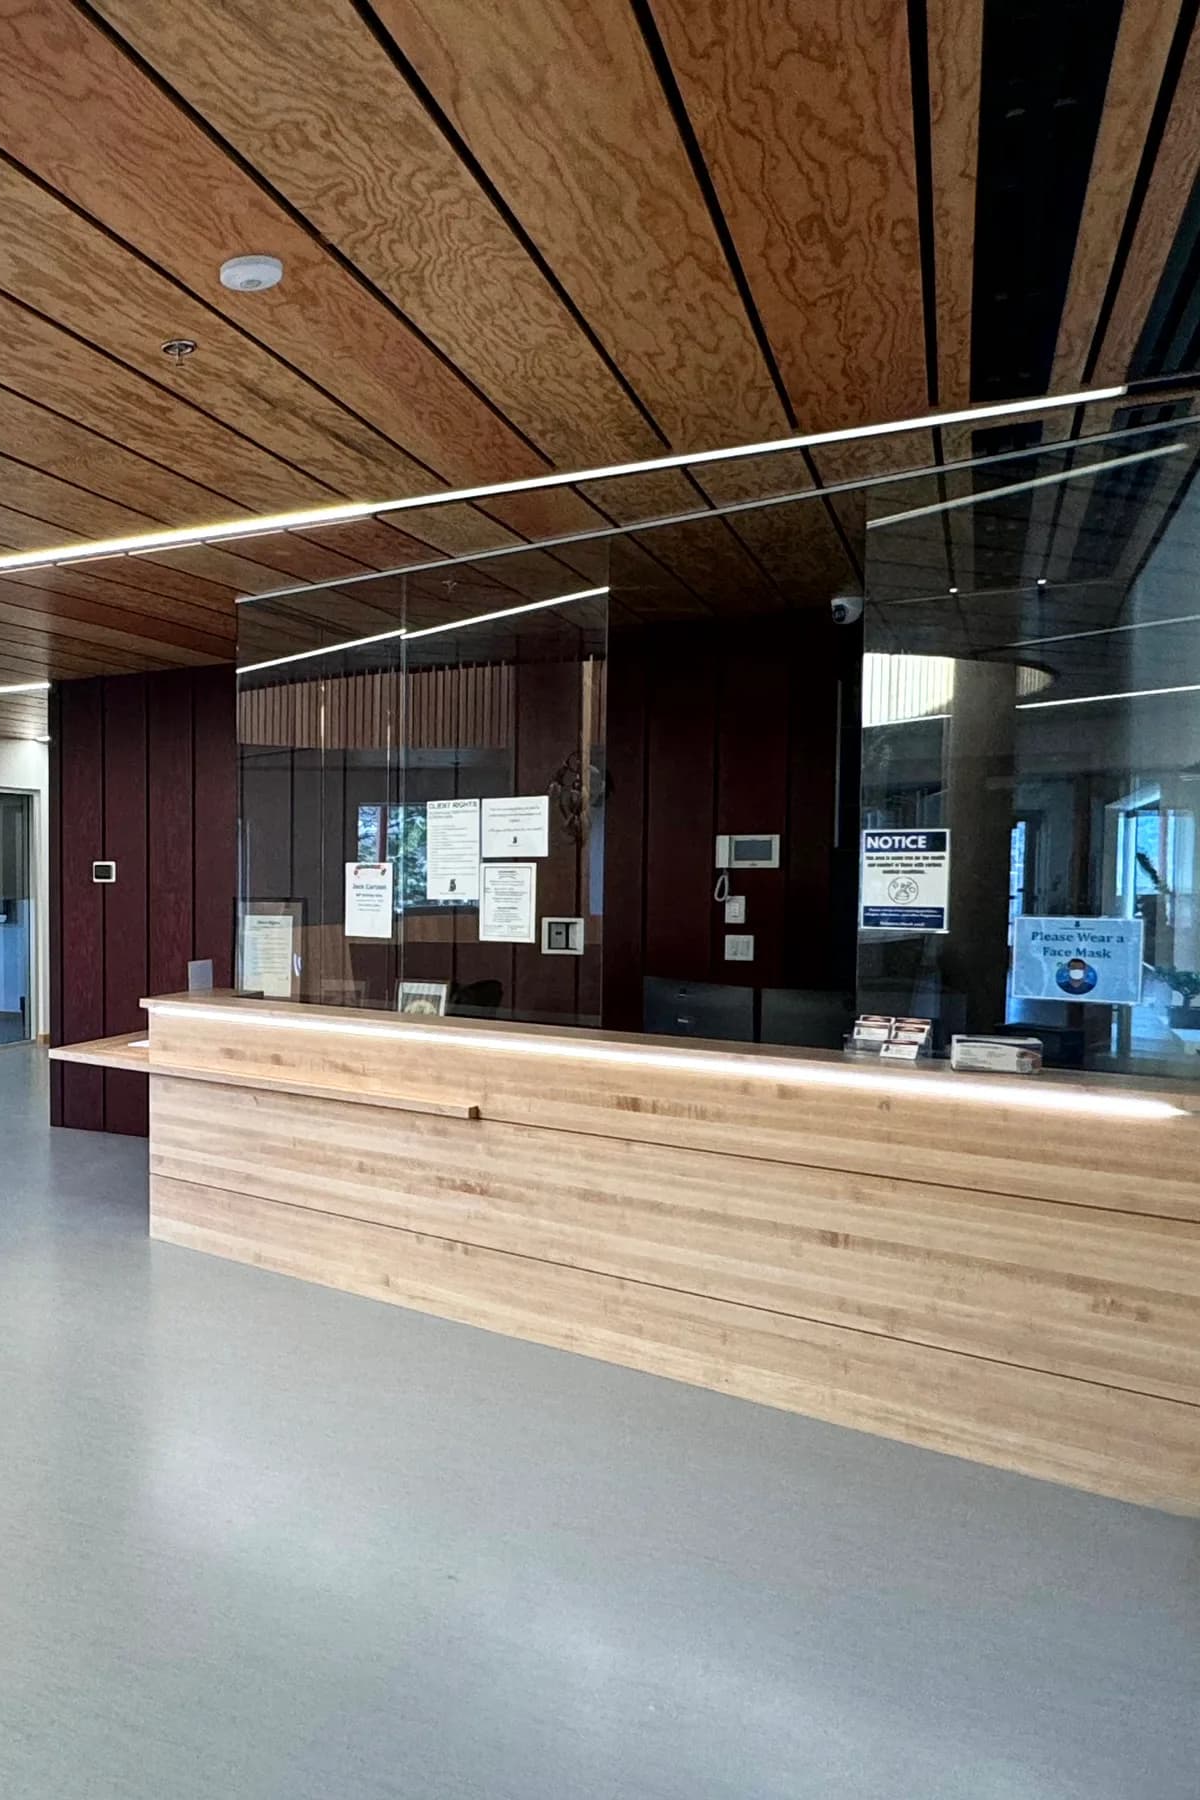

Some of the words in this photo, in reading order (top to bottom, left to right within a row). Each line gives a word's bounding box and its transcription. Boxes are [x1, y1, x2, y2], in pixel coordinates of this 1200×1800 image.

[866, 835, 927, 849] NOTICE
[1031, 931, 1074, 943] Please
[1076, 932, 1114, 944] Wear
[1116, 934, 1125, 944] a
[1043, 946, 1072, 957] Face
[1075, 947, 1112, 959] Mask
